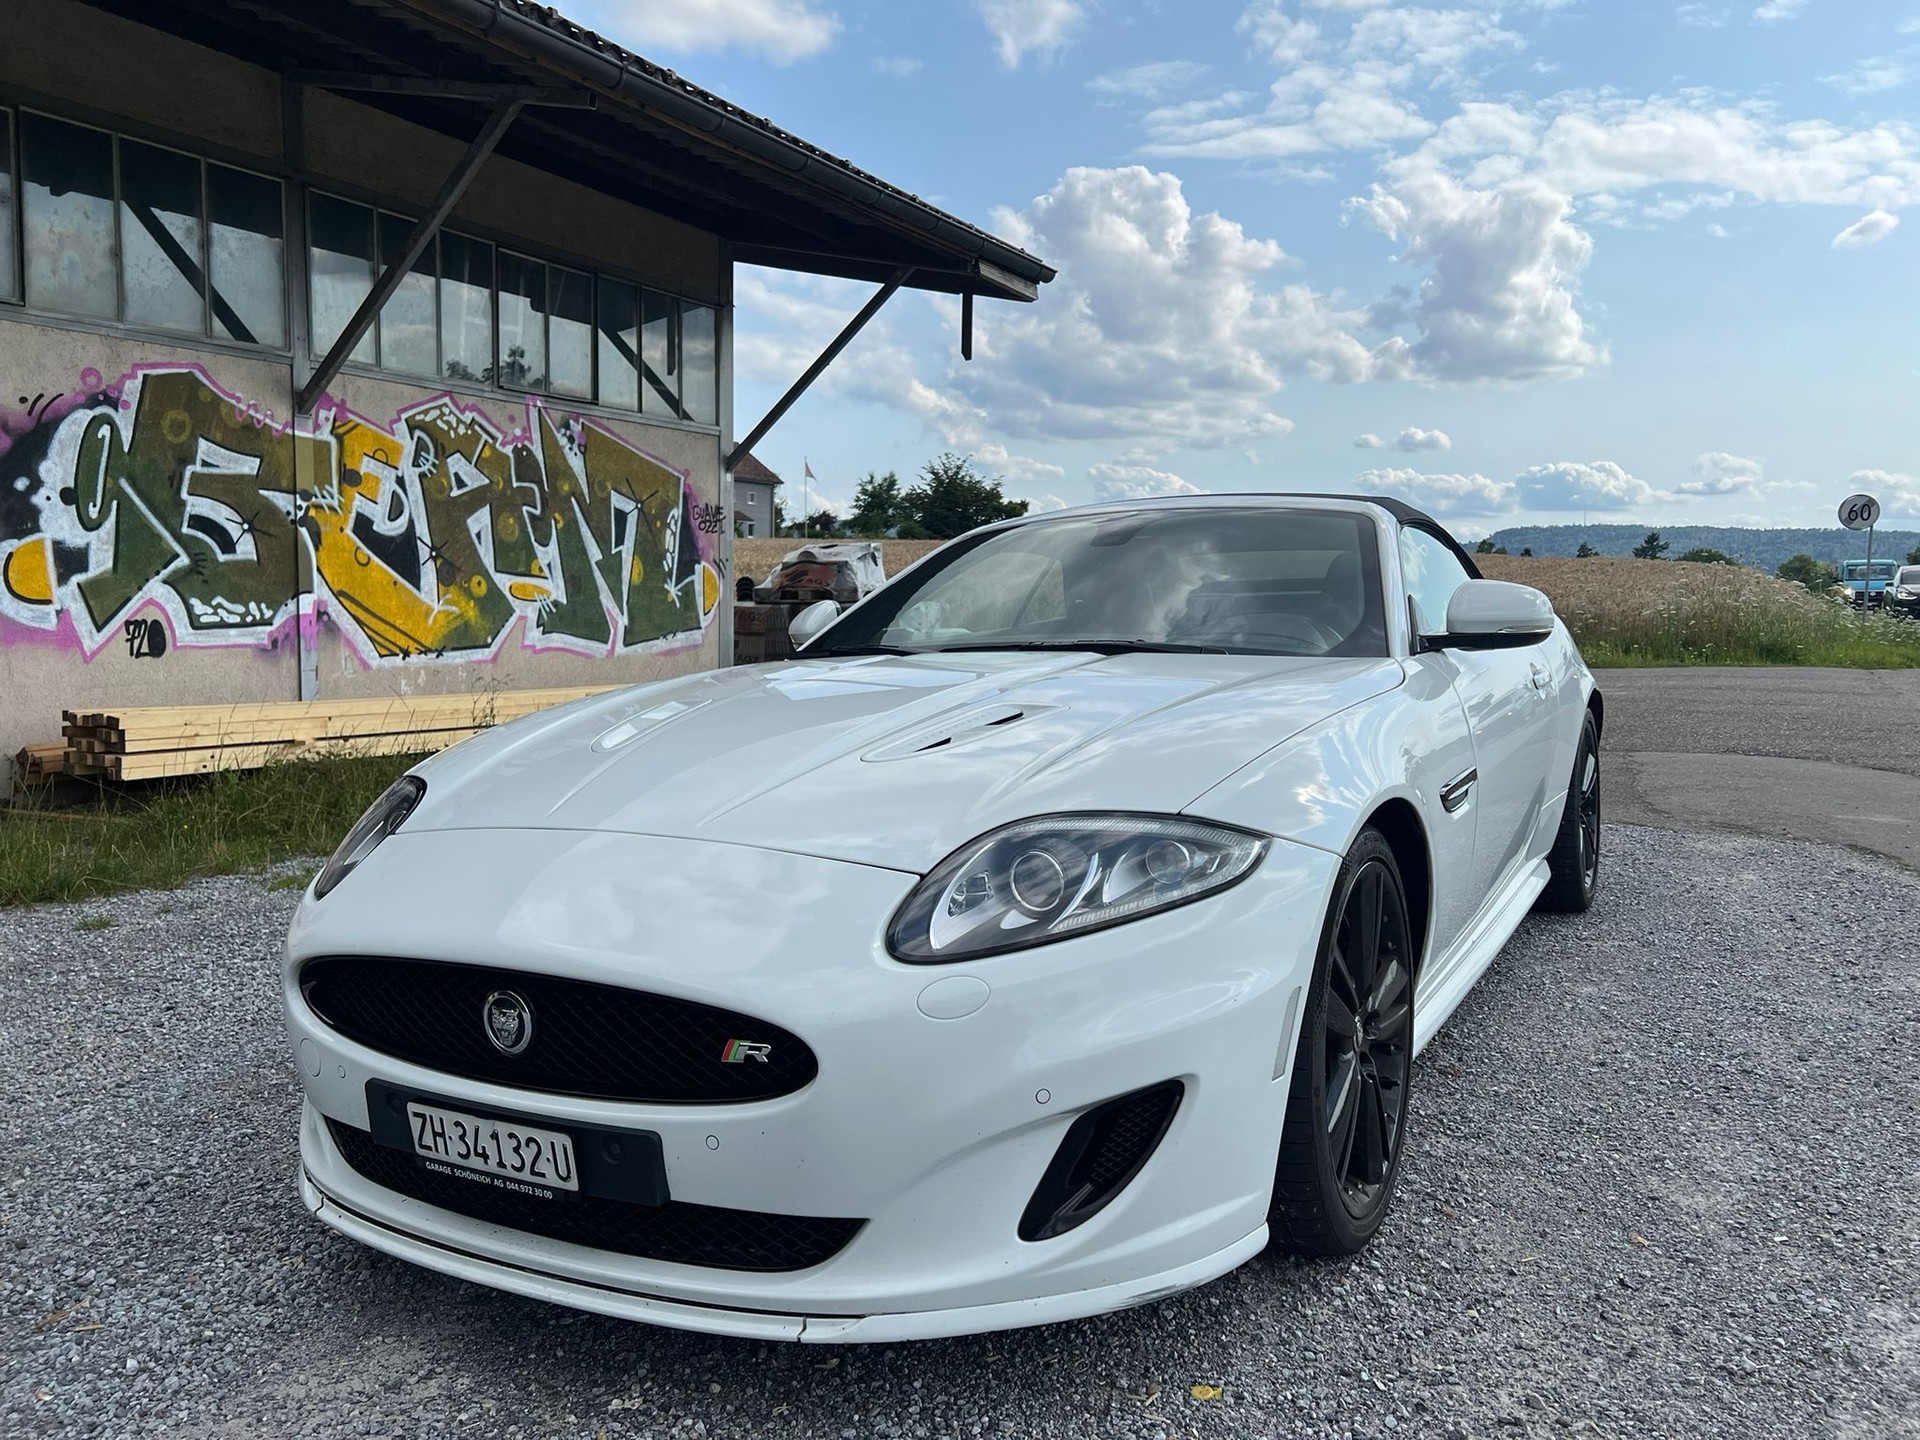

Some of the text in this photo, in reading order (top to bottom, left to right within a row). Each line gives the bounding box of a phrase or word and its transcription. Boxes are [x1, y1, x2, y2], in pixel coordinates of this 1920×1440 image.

[1847, 503, 1872, 521] 60
[124, 618, 167, 659] 720
[425, 1161, 452, 1175] GARAGE
[454, 1168, 491, 1185] SCHÖNEICH
[493, 1178, 504, 1188] AG
[534, 1187, 543, 1197] 30
[543, 1190, 553, 1199] 00
